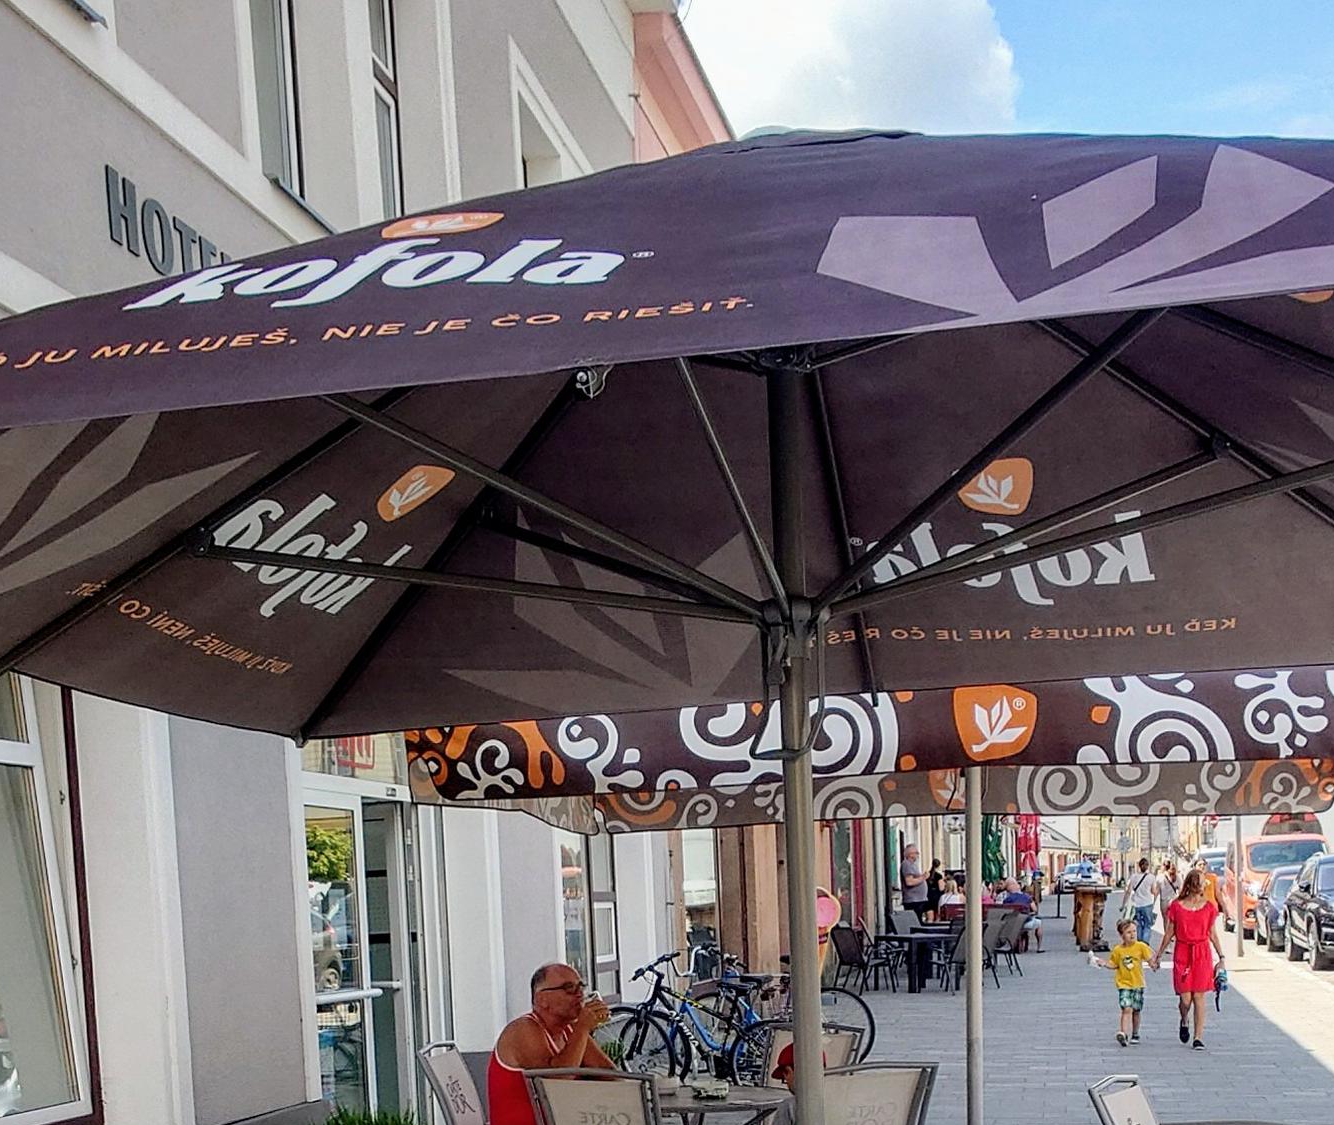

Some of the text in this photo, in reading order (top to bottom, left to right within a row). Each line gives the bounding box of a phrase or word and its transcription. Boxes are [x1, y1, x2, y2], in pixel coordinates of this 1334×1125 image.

[104, 163, 232, 277] HOT
[122, 237, 627, 312] kofola
[15, 348, 78, 368] JU
[321, 322, 406, 341] NIE
[413, 318, 471, 335] JE
[491, 312, 562, 328] ČO
